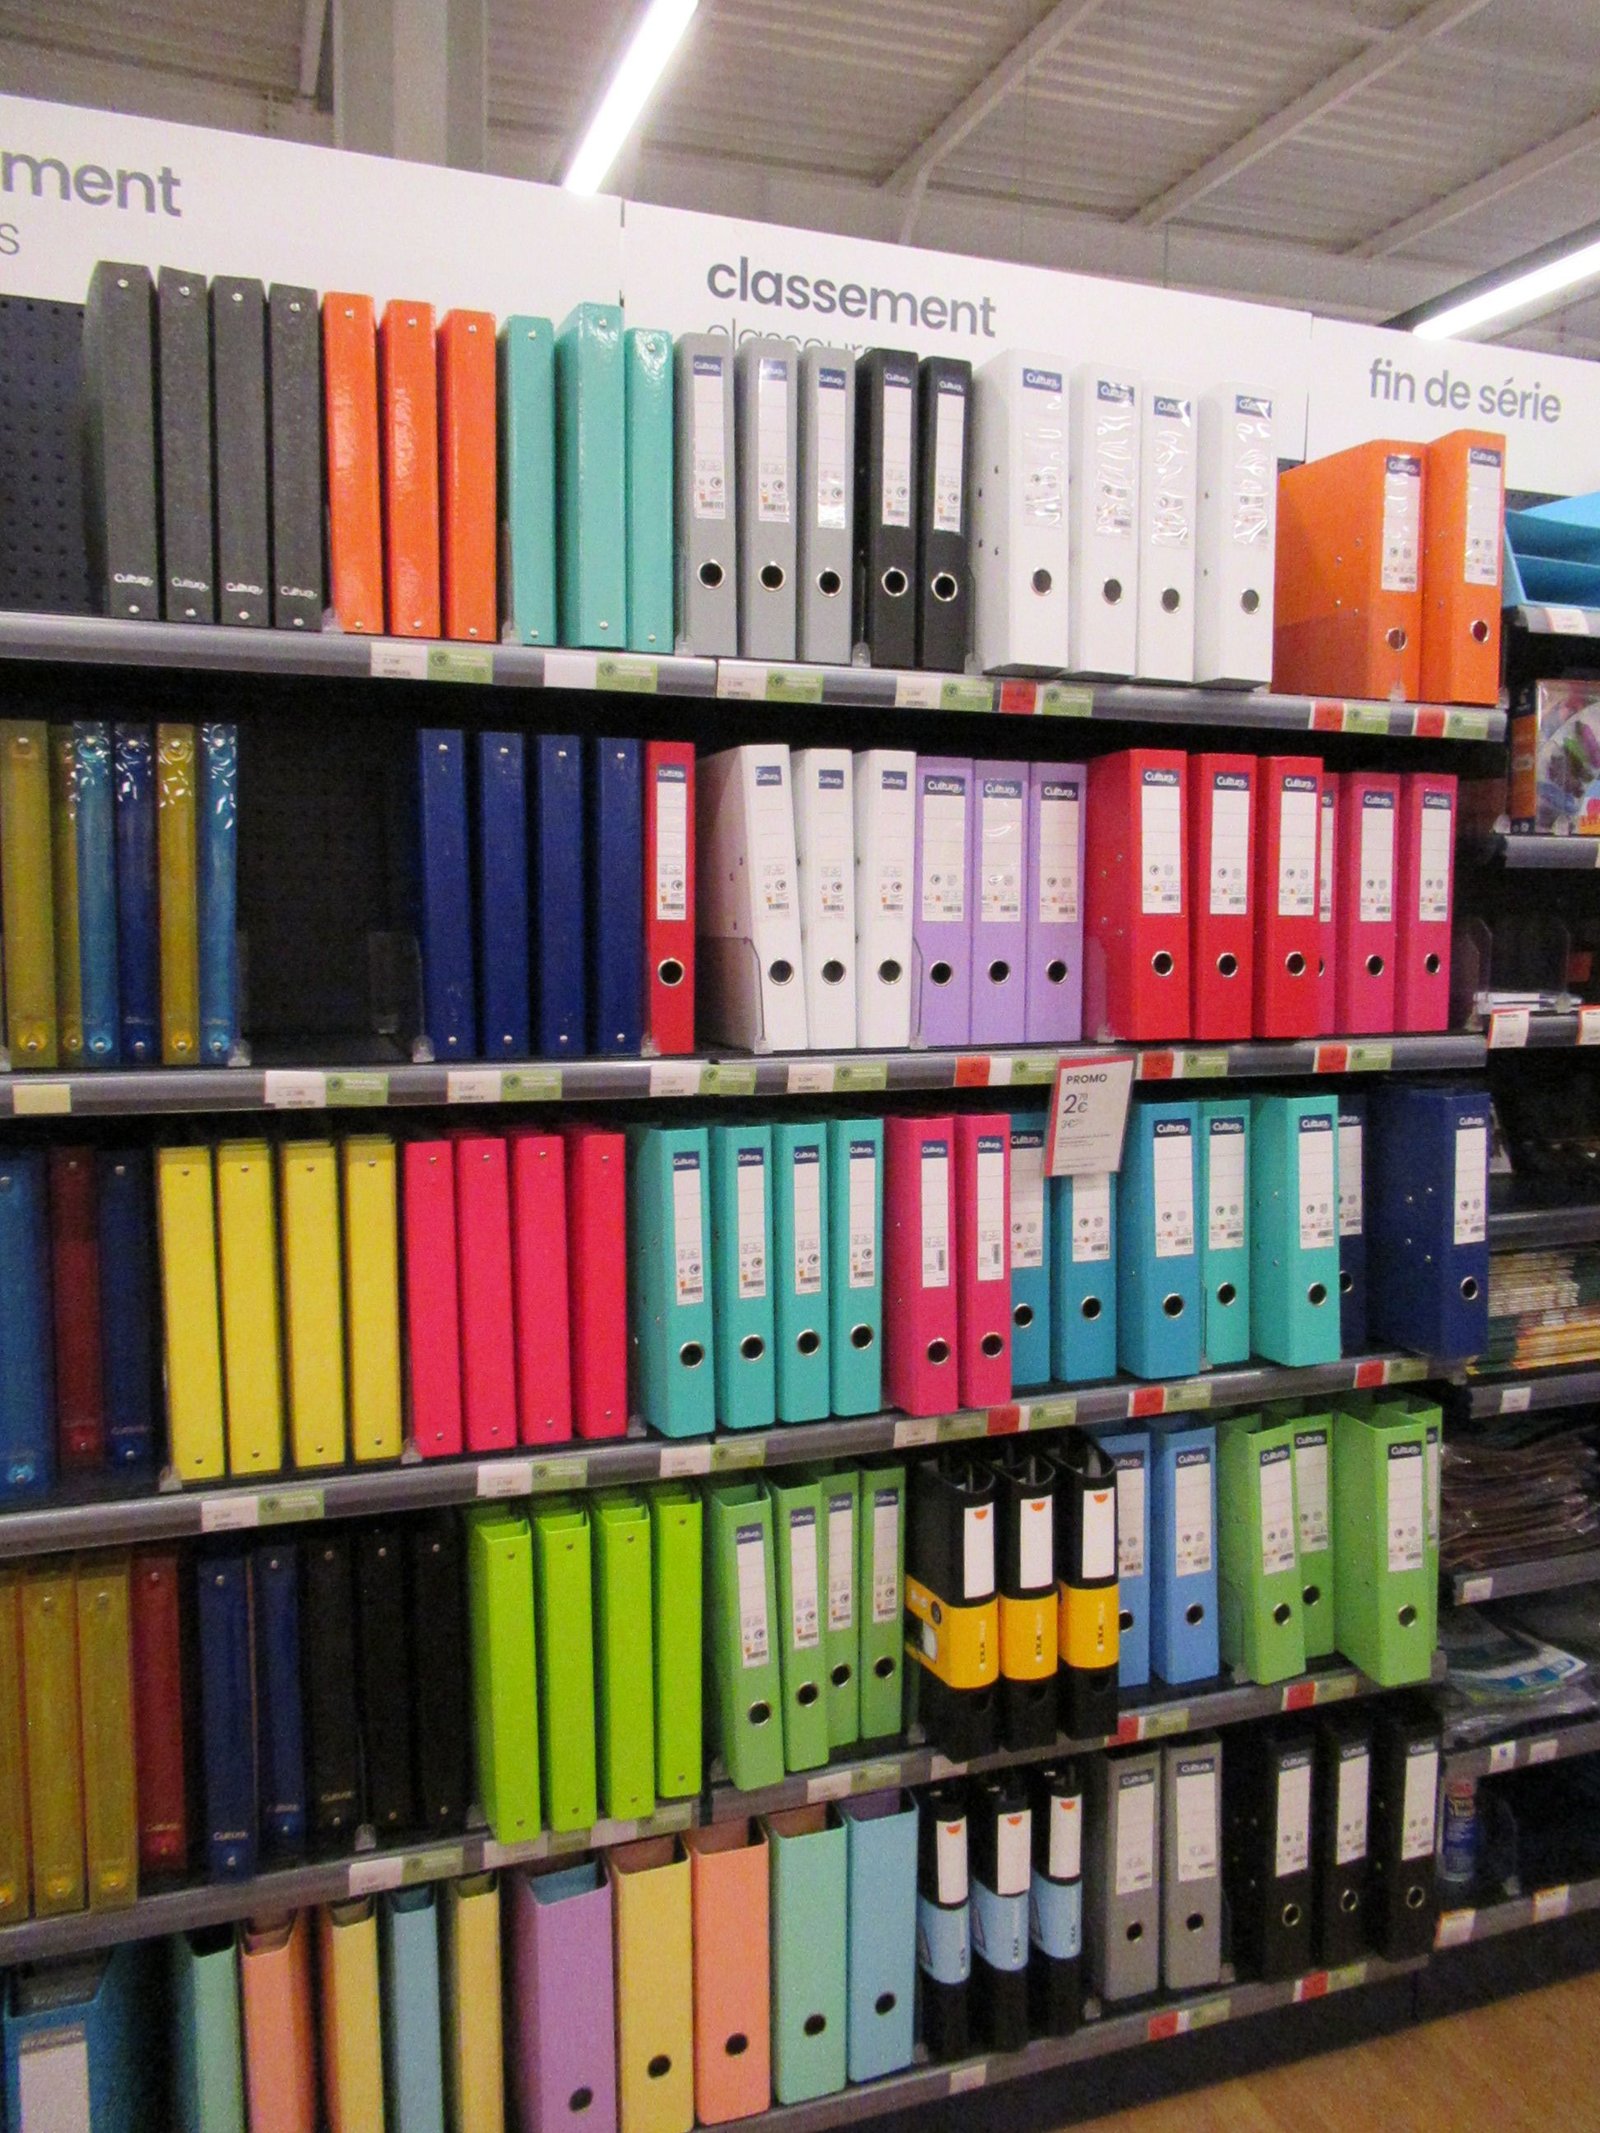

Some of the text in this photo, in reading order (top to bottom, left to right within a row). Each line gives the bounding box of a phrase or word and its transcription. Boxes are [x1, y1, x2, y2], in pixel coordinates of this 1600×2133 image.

[706, 256, 996, 338] classement
[1369, 358, 1561, 423] fin de série
[1144, 771, 1177, 784] Cultura
[1216, 776, 1248, 789] Cultura
[1285, 778, 1315, 790] Cultura
[928, 781, 961, 793] Cultura
[984, 782, 1018, 796] Cultura
[1044, 785, 1076, 798] Cultura
[1066, 1074, 1107, 1084] PROMO
[1157, 1123, 1189, 1133] Cultura
